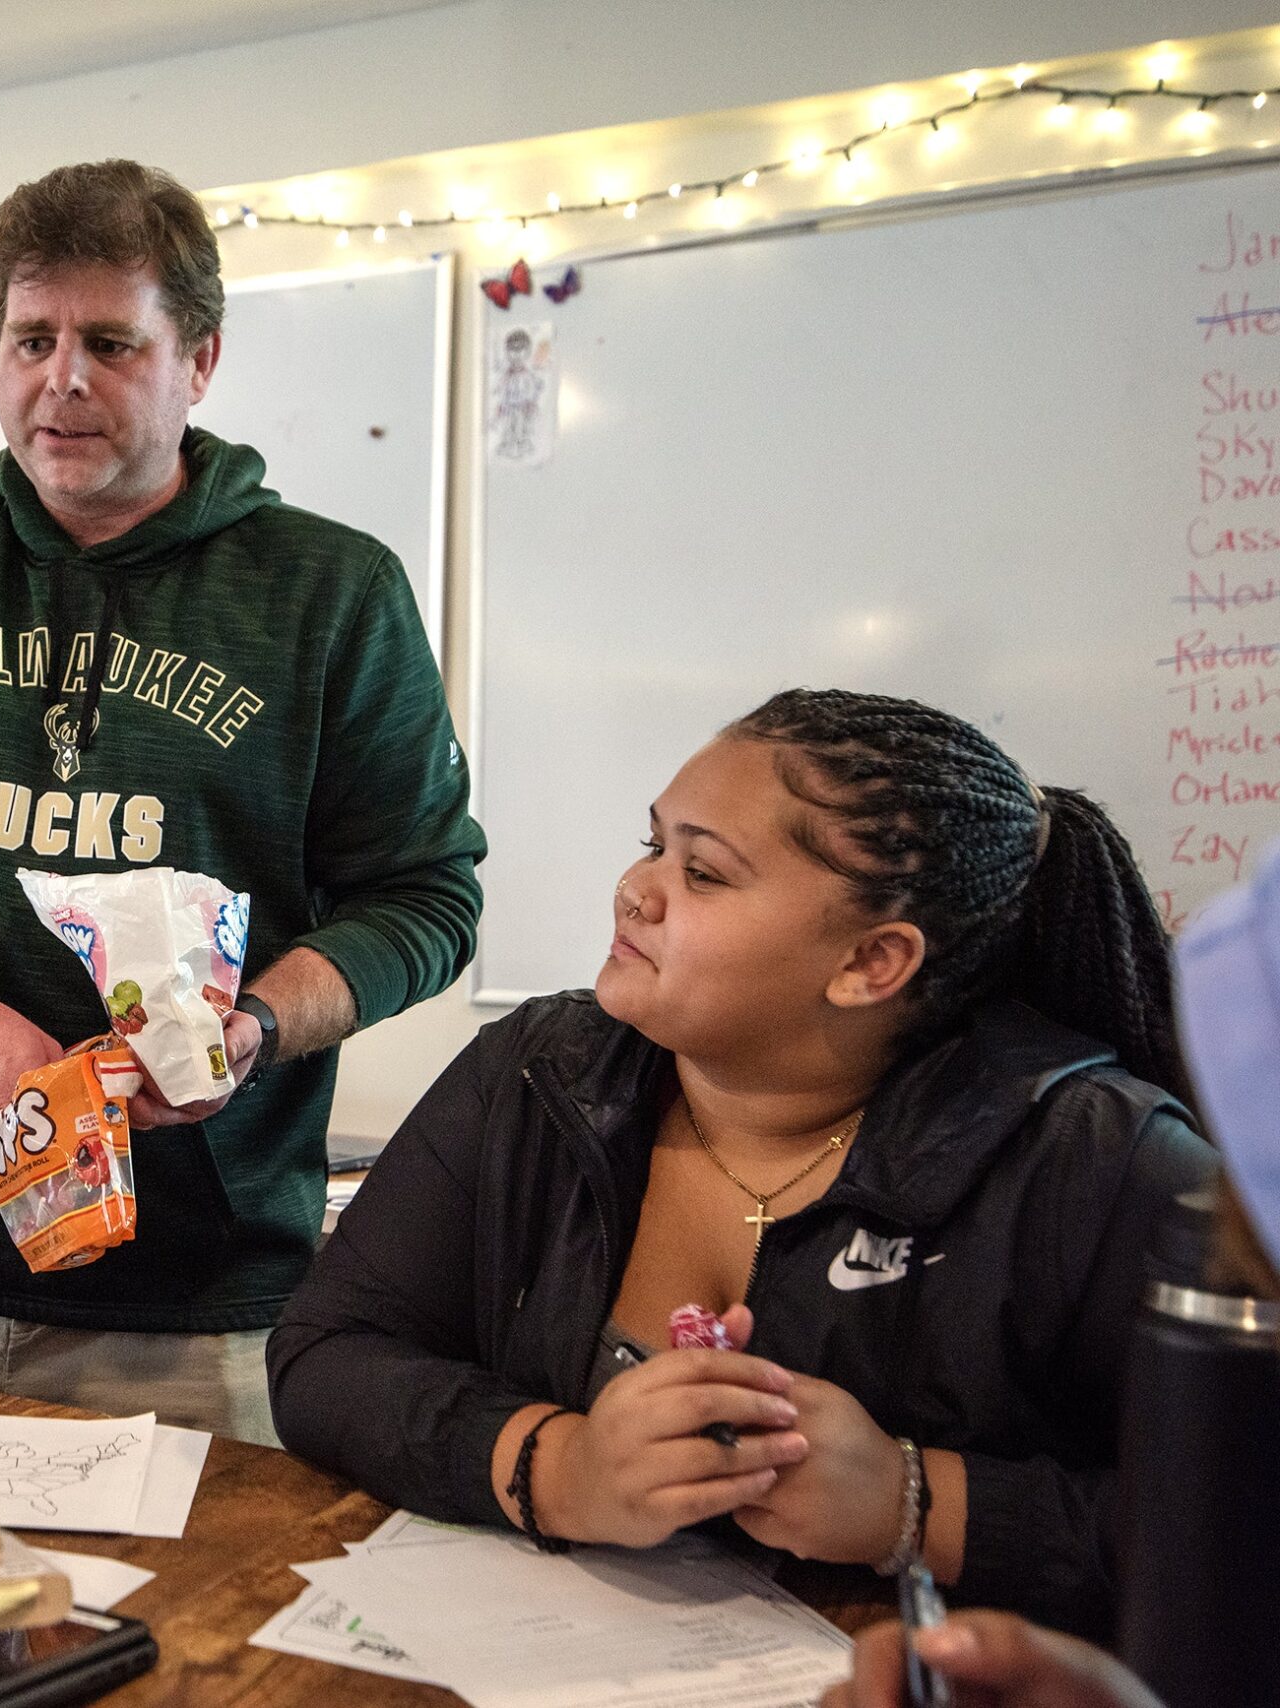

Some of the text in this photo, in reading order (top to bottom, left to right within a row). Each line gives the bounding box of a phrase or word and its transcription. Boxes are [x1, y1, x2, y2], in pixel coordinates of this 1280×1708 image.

[1170, 824, 1249, 881] Zay
[32, 1157, 50, 1167] ROLL
[846, 1228, 915, 1275] NIKE
